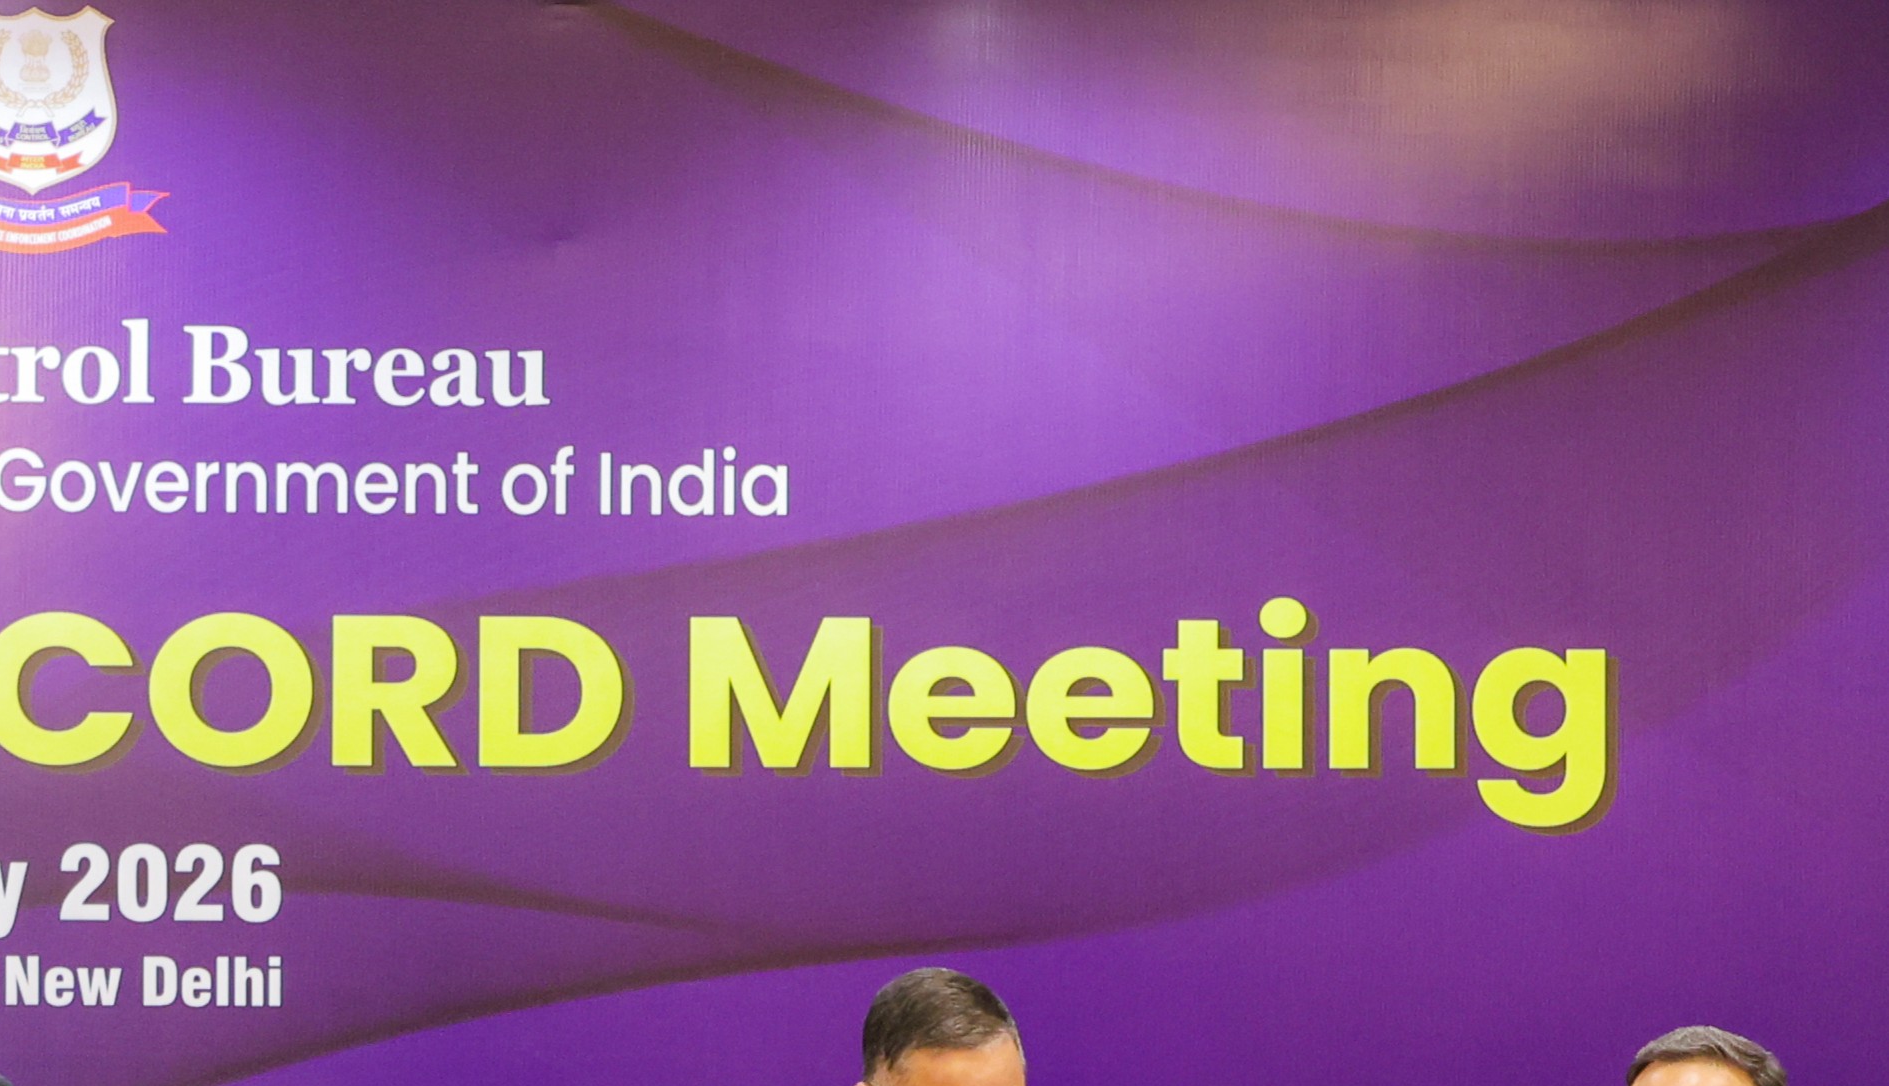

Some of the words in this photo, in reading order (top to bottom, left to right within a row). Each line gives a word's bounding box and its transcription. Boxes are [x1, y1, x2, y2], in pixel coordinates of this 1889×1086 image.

[183, 325, 550, 407] Bureau
[502, 446, 574, 515] of
[600, 446, 789, 516] India
[688, 597, 1607, 828] Meeting
[59, 842, 282, 924] 2026
[4, 955, 122, 1006] New
[143, 956, 282, 1007] Delhi
